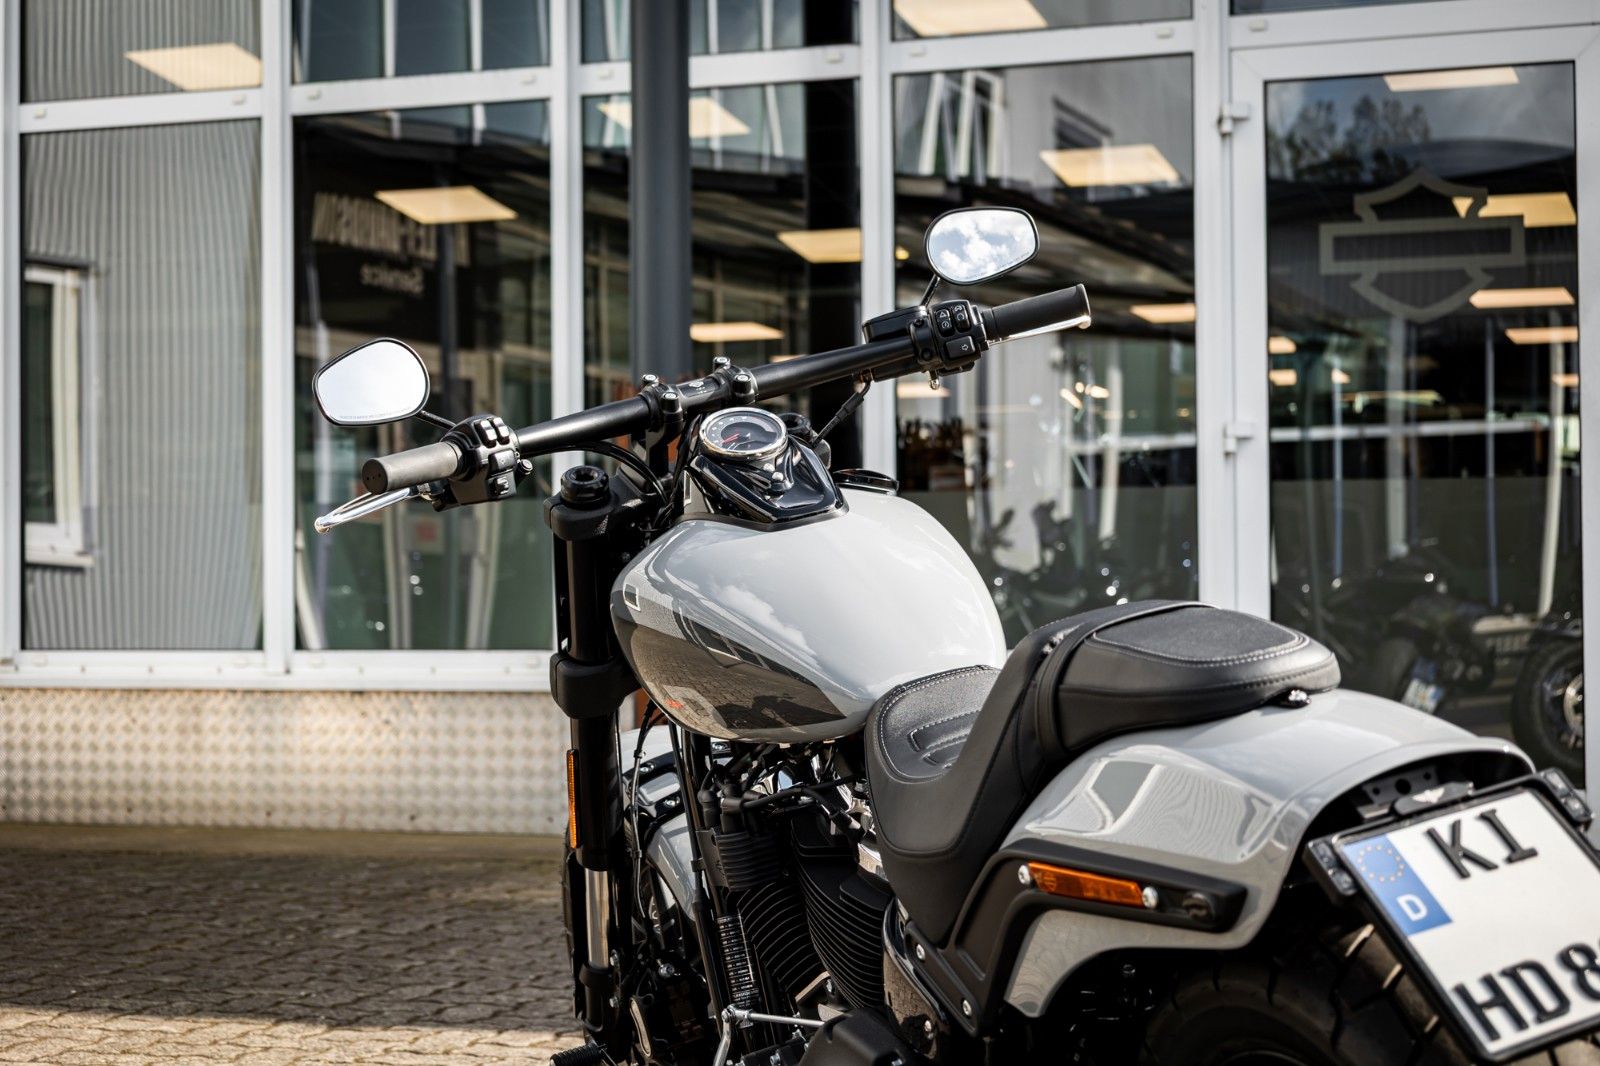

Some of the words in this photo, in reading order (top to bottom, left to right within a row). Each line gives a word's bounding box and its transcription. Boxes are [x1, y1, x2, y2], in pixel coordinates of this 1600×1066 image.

[1426, 808, 1539, 880] KI
[1395, 893, 1428, 922] D
[1451, 941, 1600, 1043] HD8
